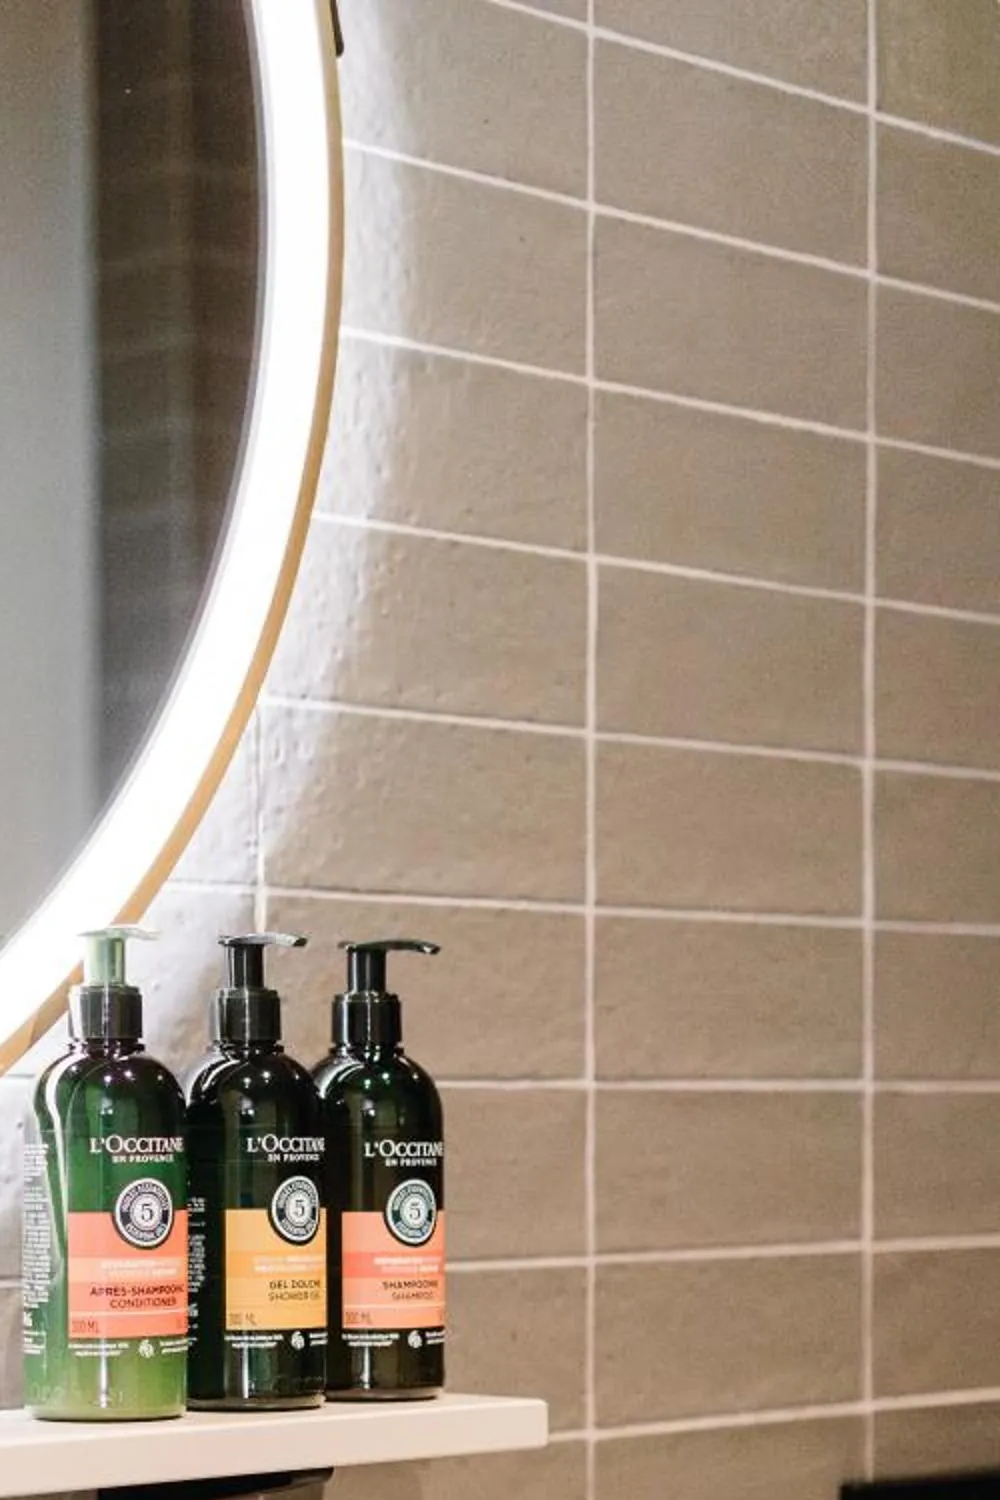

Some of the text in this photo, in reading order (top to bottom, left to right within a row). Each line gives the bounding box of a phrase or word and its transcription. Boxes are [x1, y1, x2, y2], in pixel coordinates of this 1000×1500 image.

[89, 1134, 184, 1154] L'OCCITANE
[246, 1133, 326, 1153] L'OCCITANE
[364, 1139, 444, 1157] L'OCCITANE
[141, 1203, 153, 1221] 5
[295, 1199, 305, 1217] 5
[409, 1202, 421, 1221] 5
